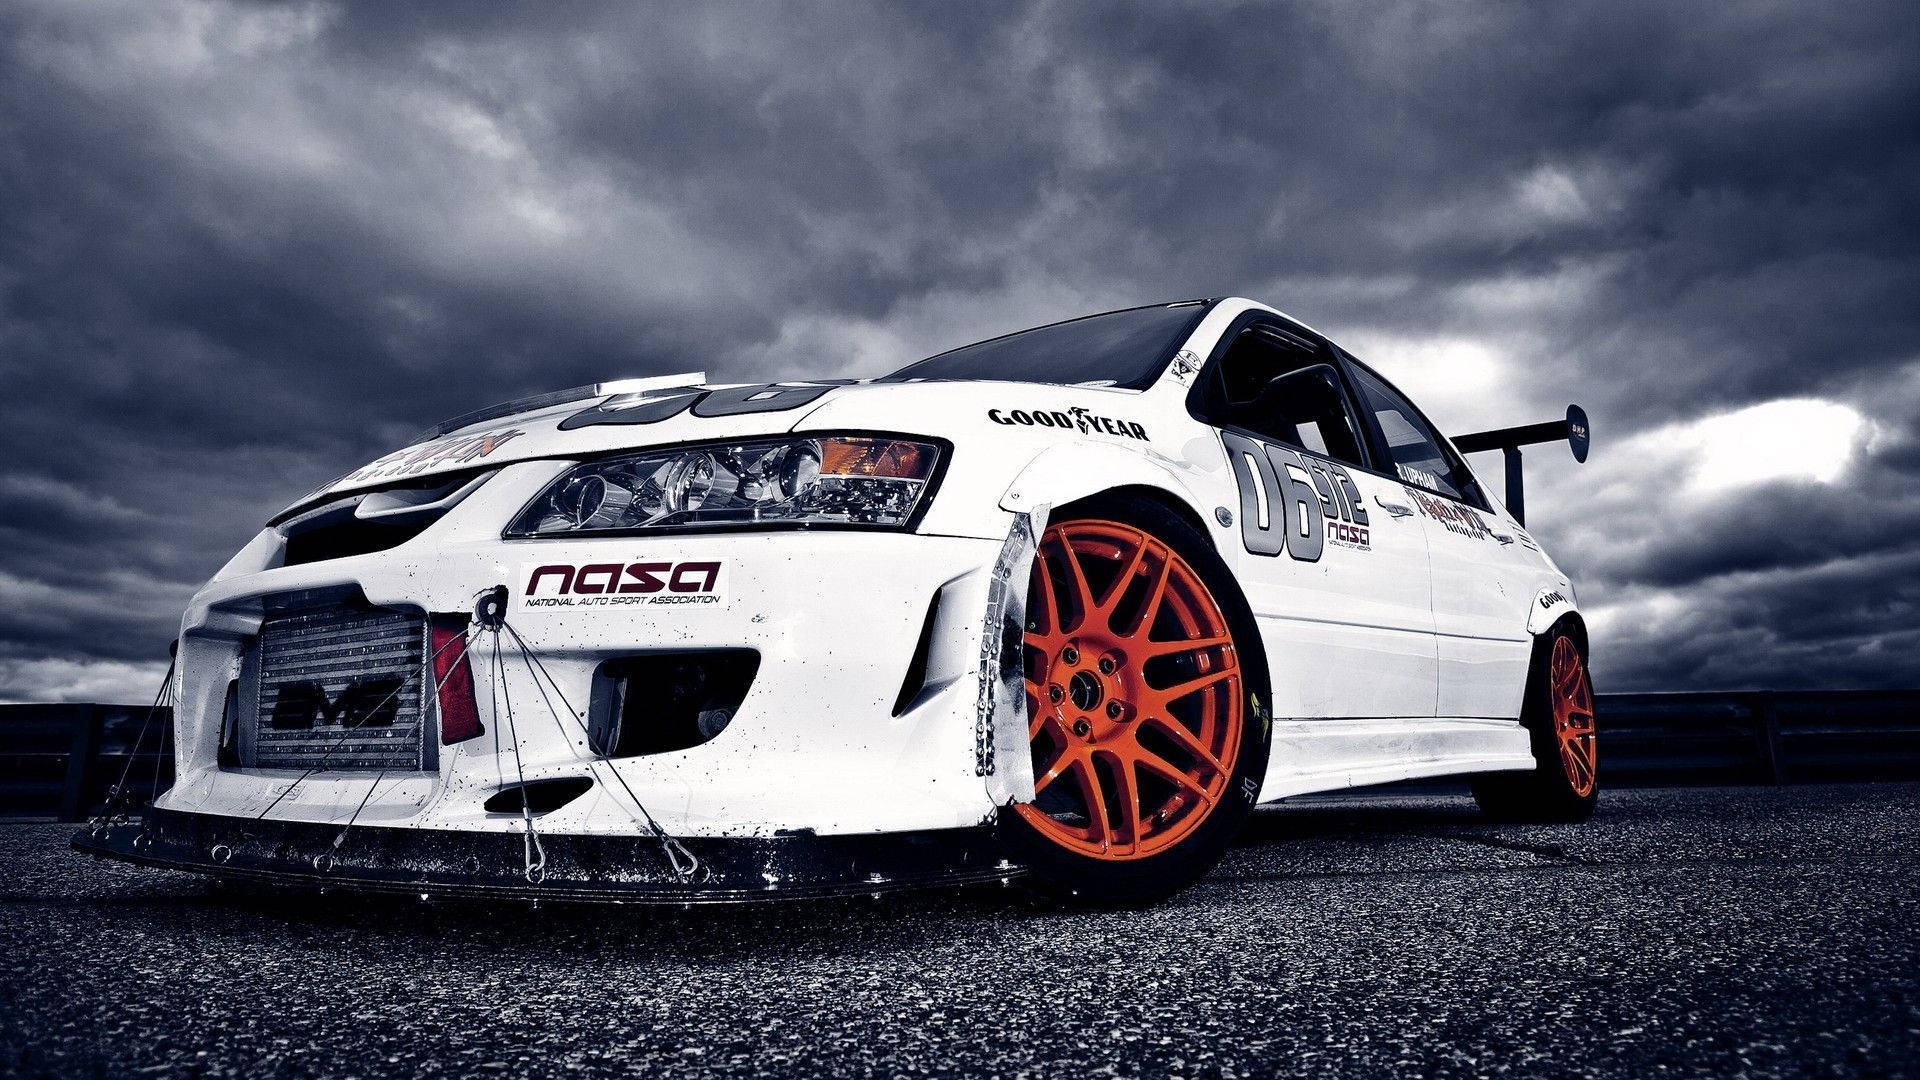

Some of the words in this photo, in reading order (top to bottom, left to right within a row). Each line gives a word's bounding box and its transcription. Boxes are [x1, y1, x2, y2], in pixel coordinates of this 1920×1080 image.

[1220, 430, 1324, 563] 06
[525, 598, 576, 607] NATIONAL
[578, 597, 608, 606] AUTO
[609, 596, 648, 605] SPORT
[648, 595, 721, 604] ASSOCIATION
